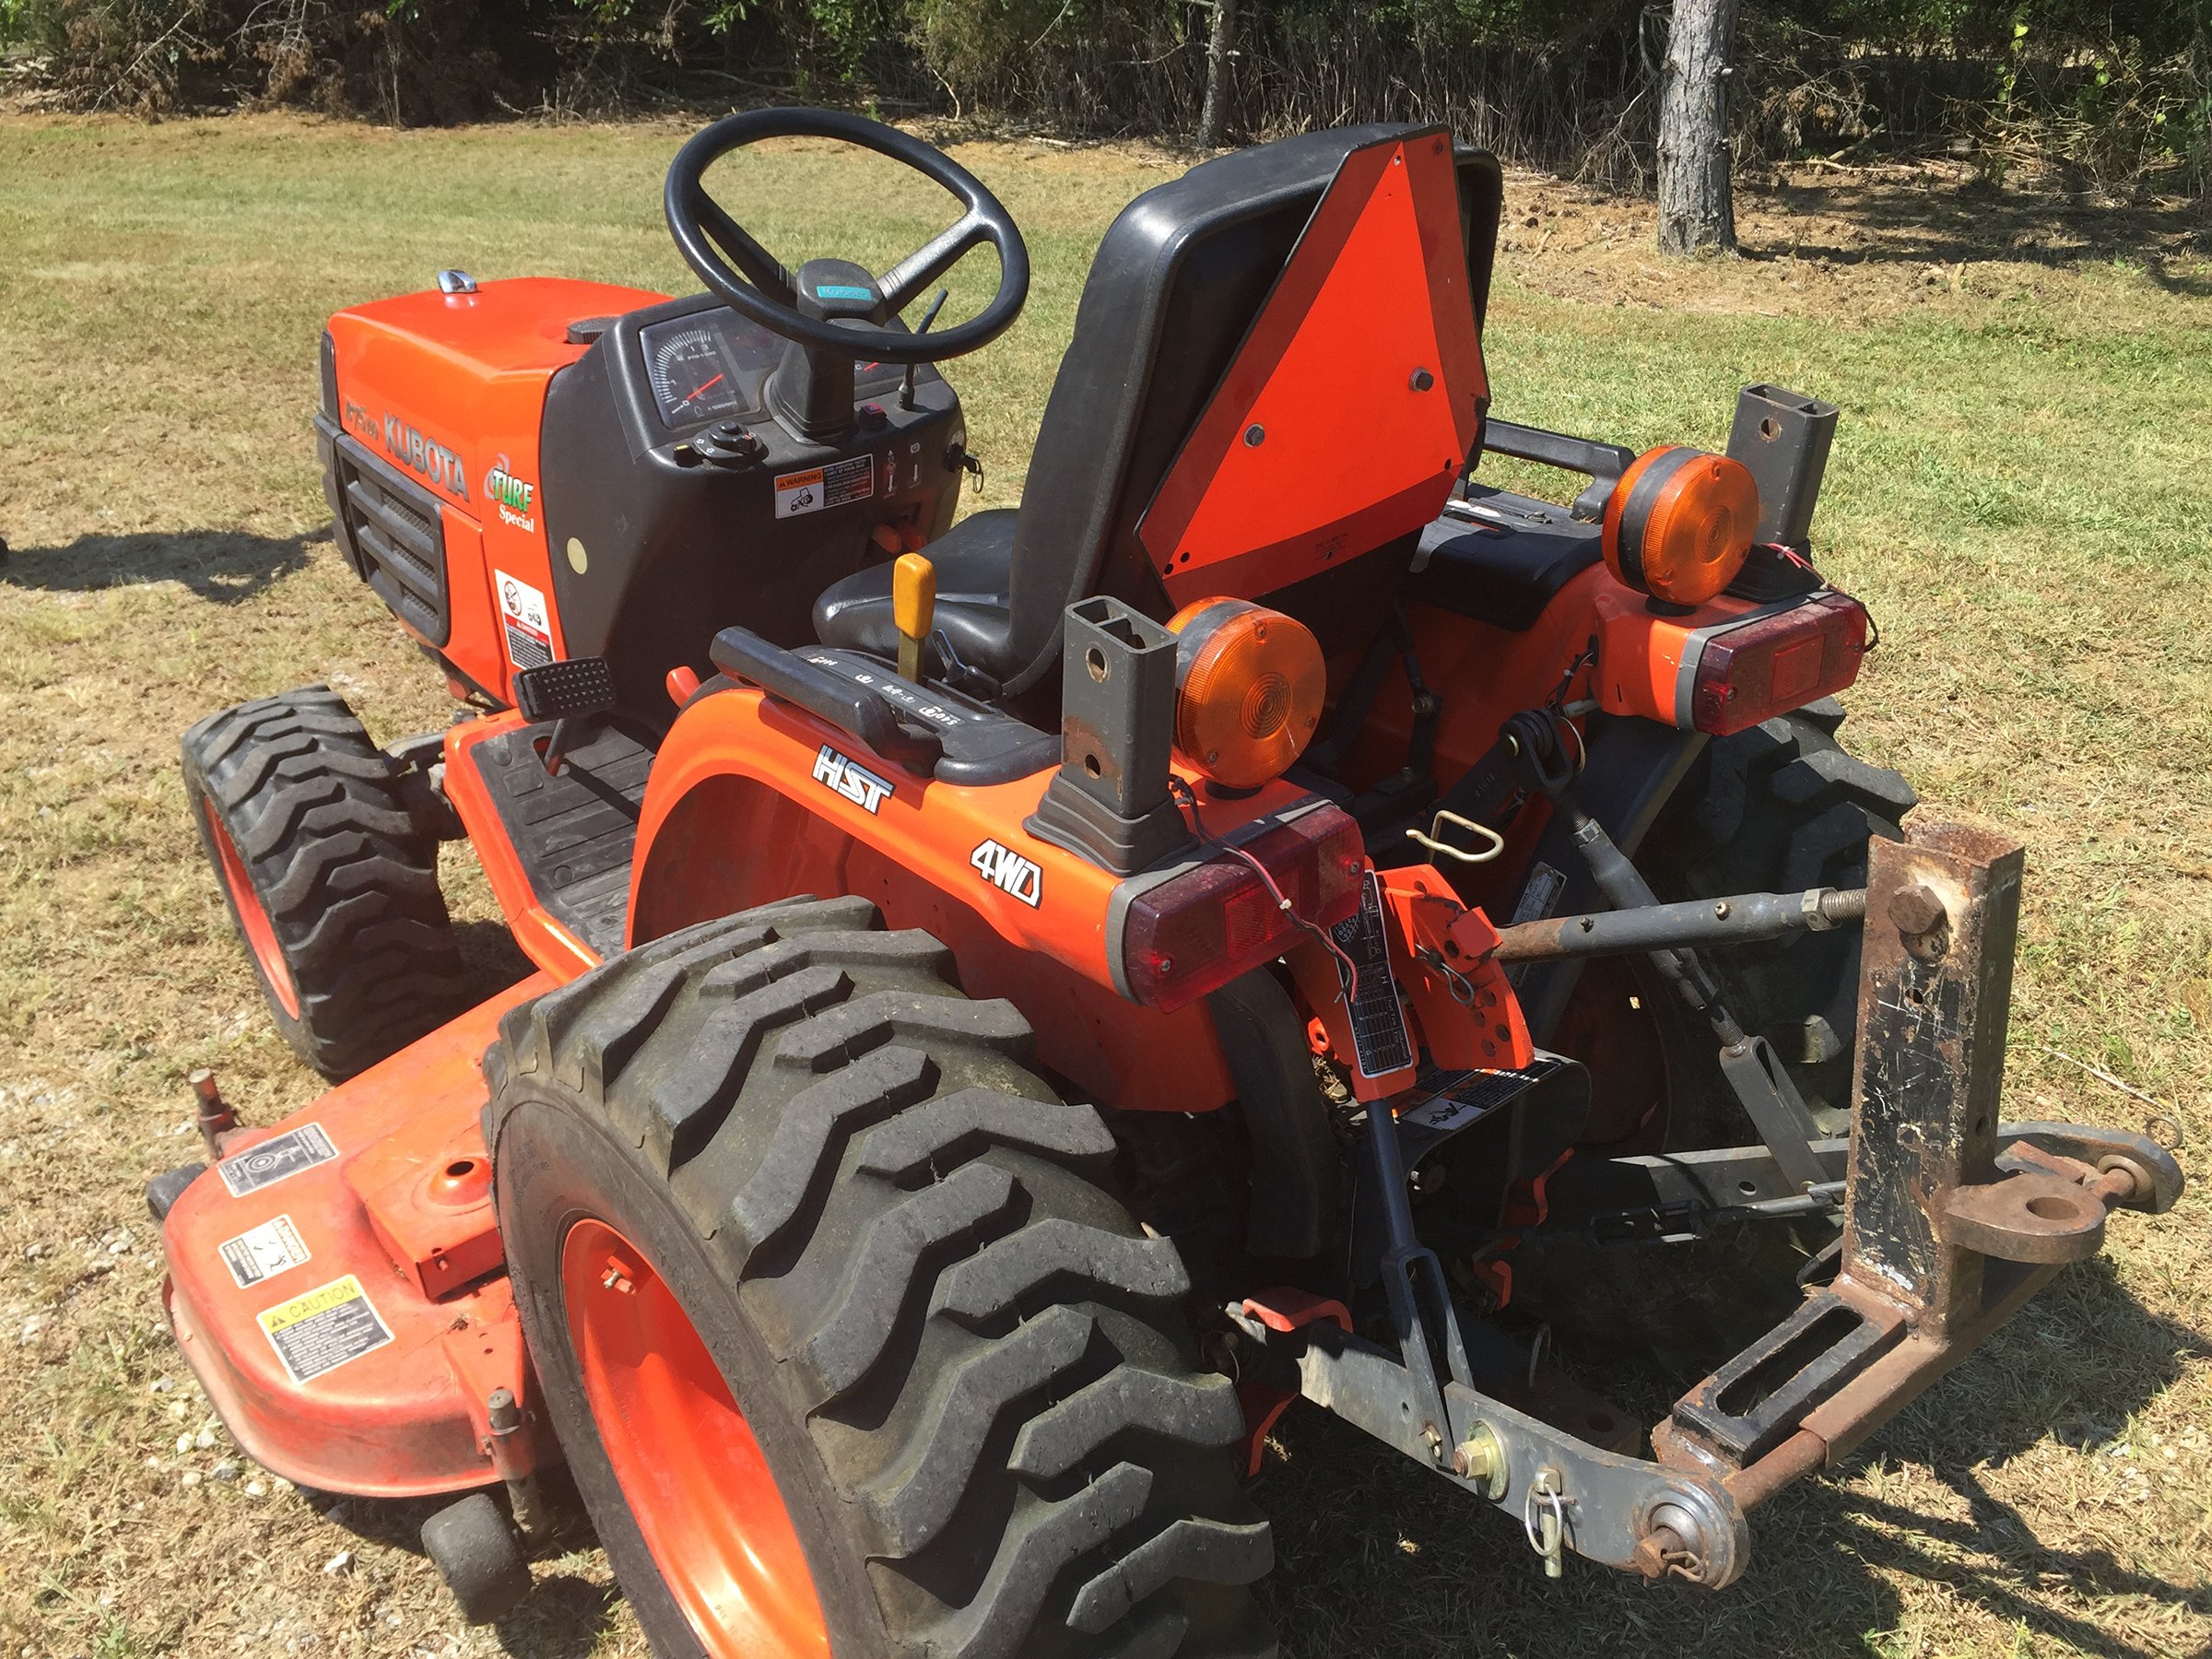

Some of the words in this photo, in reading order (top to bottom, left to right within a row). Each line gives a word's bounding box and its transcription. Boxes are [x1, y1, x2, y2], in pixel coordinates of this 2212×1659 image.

[384, 411, 469, 503] KUBOTA
[786, 472, 822, 486] WARNING
[493, 468, 534, 512] TURF
[499, 504, 534, 533] Special
[812, 744, 896, 816] HST
[970, 838, 1042, 910] 4WD
[289, 1283, 355, 1318] CAUTION
